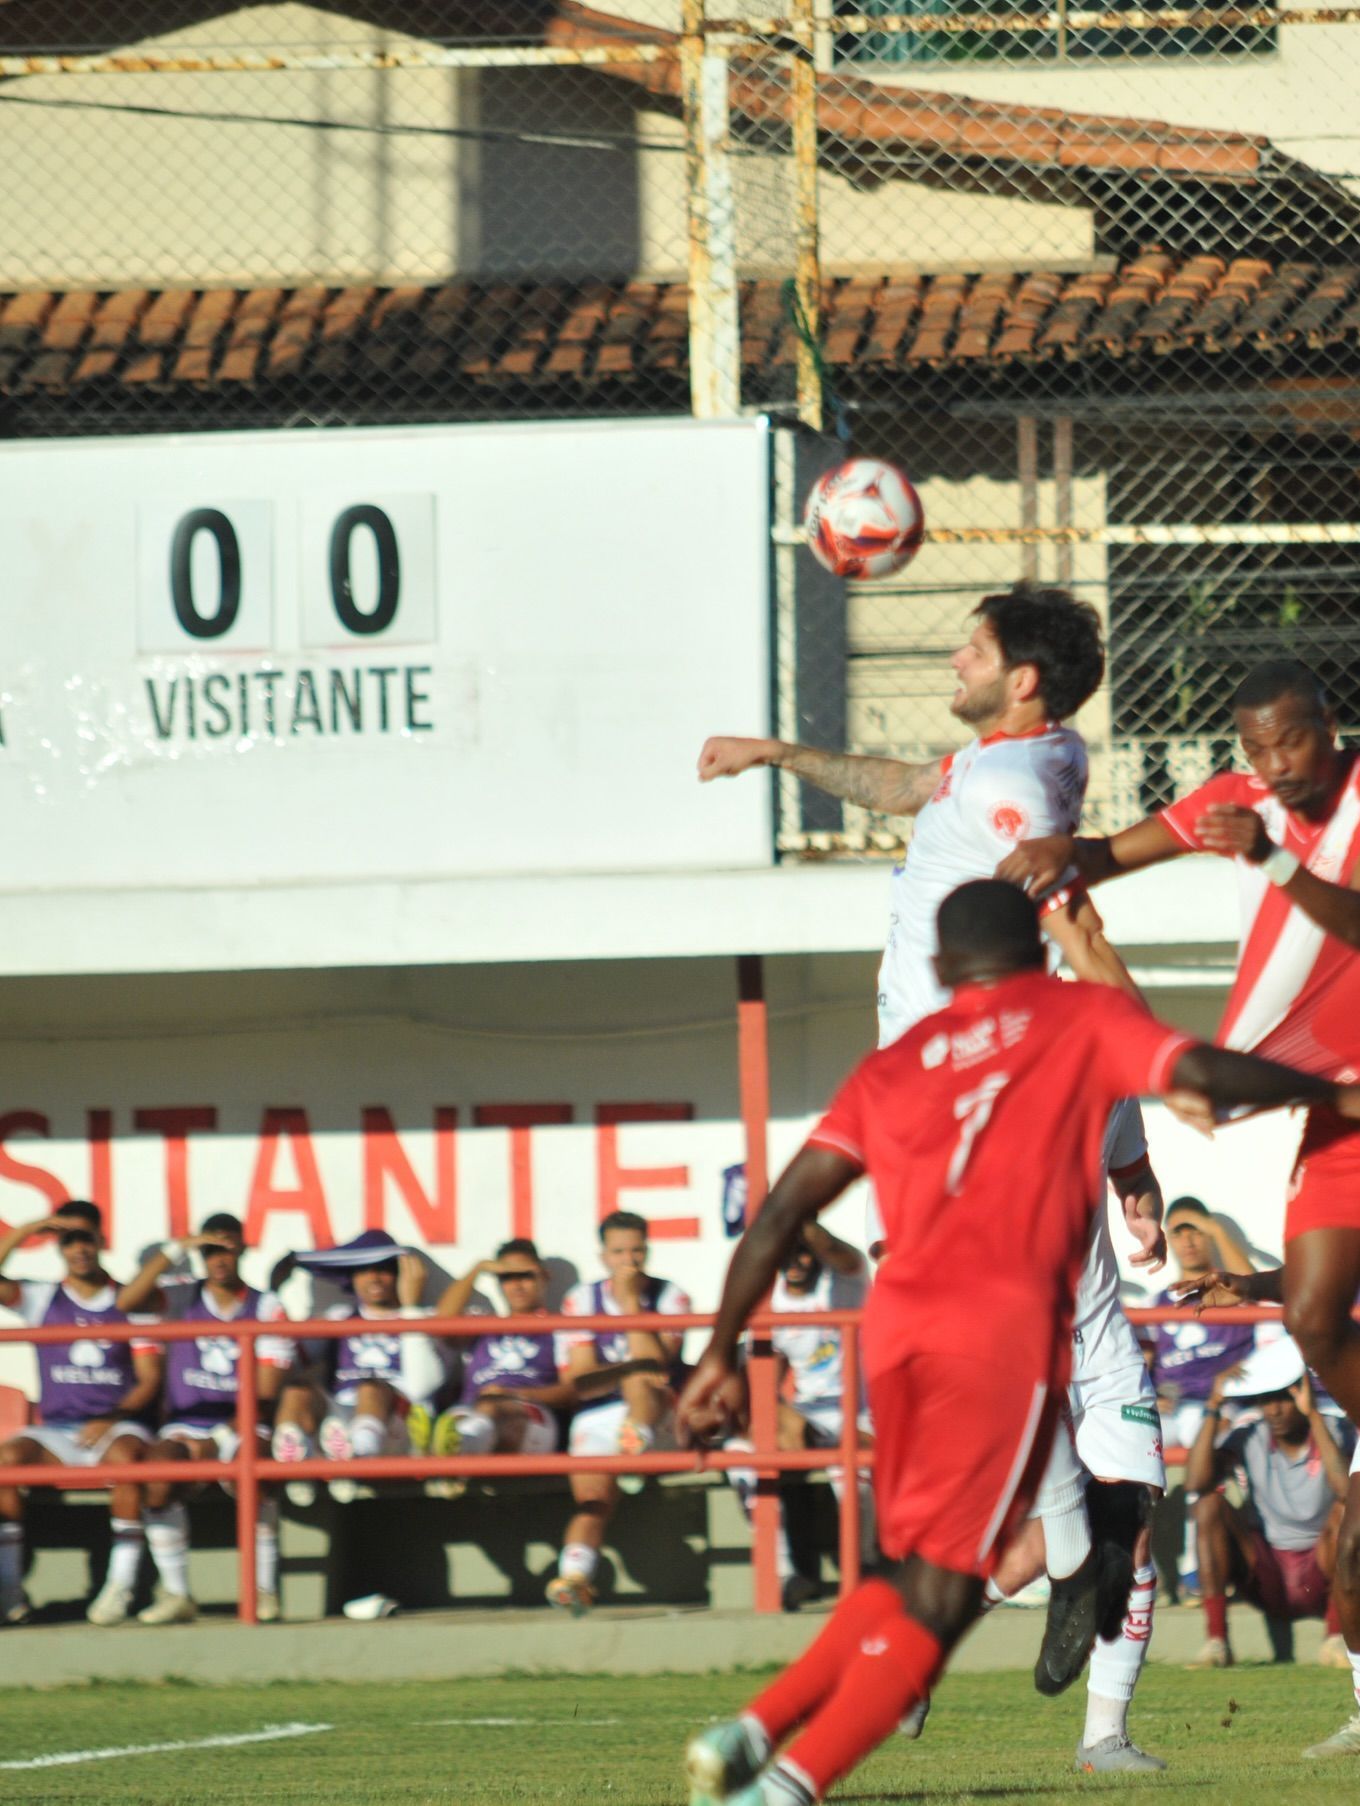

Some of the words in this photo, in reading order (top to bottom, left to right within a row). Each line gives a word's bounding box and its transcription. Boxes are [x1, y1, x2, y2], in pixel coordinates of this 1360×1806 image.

[169, 506, 242, 639] 0
[328, 503, 401, 635] 0
[144, 665, 433, 741] VISITANTE
[946, 1069, 1011, 1198] 7
